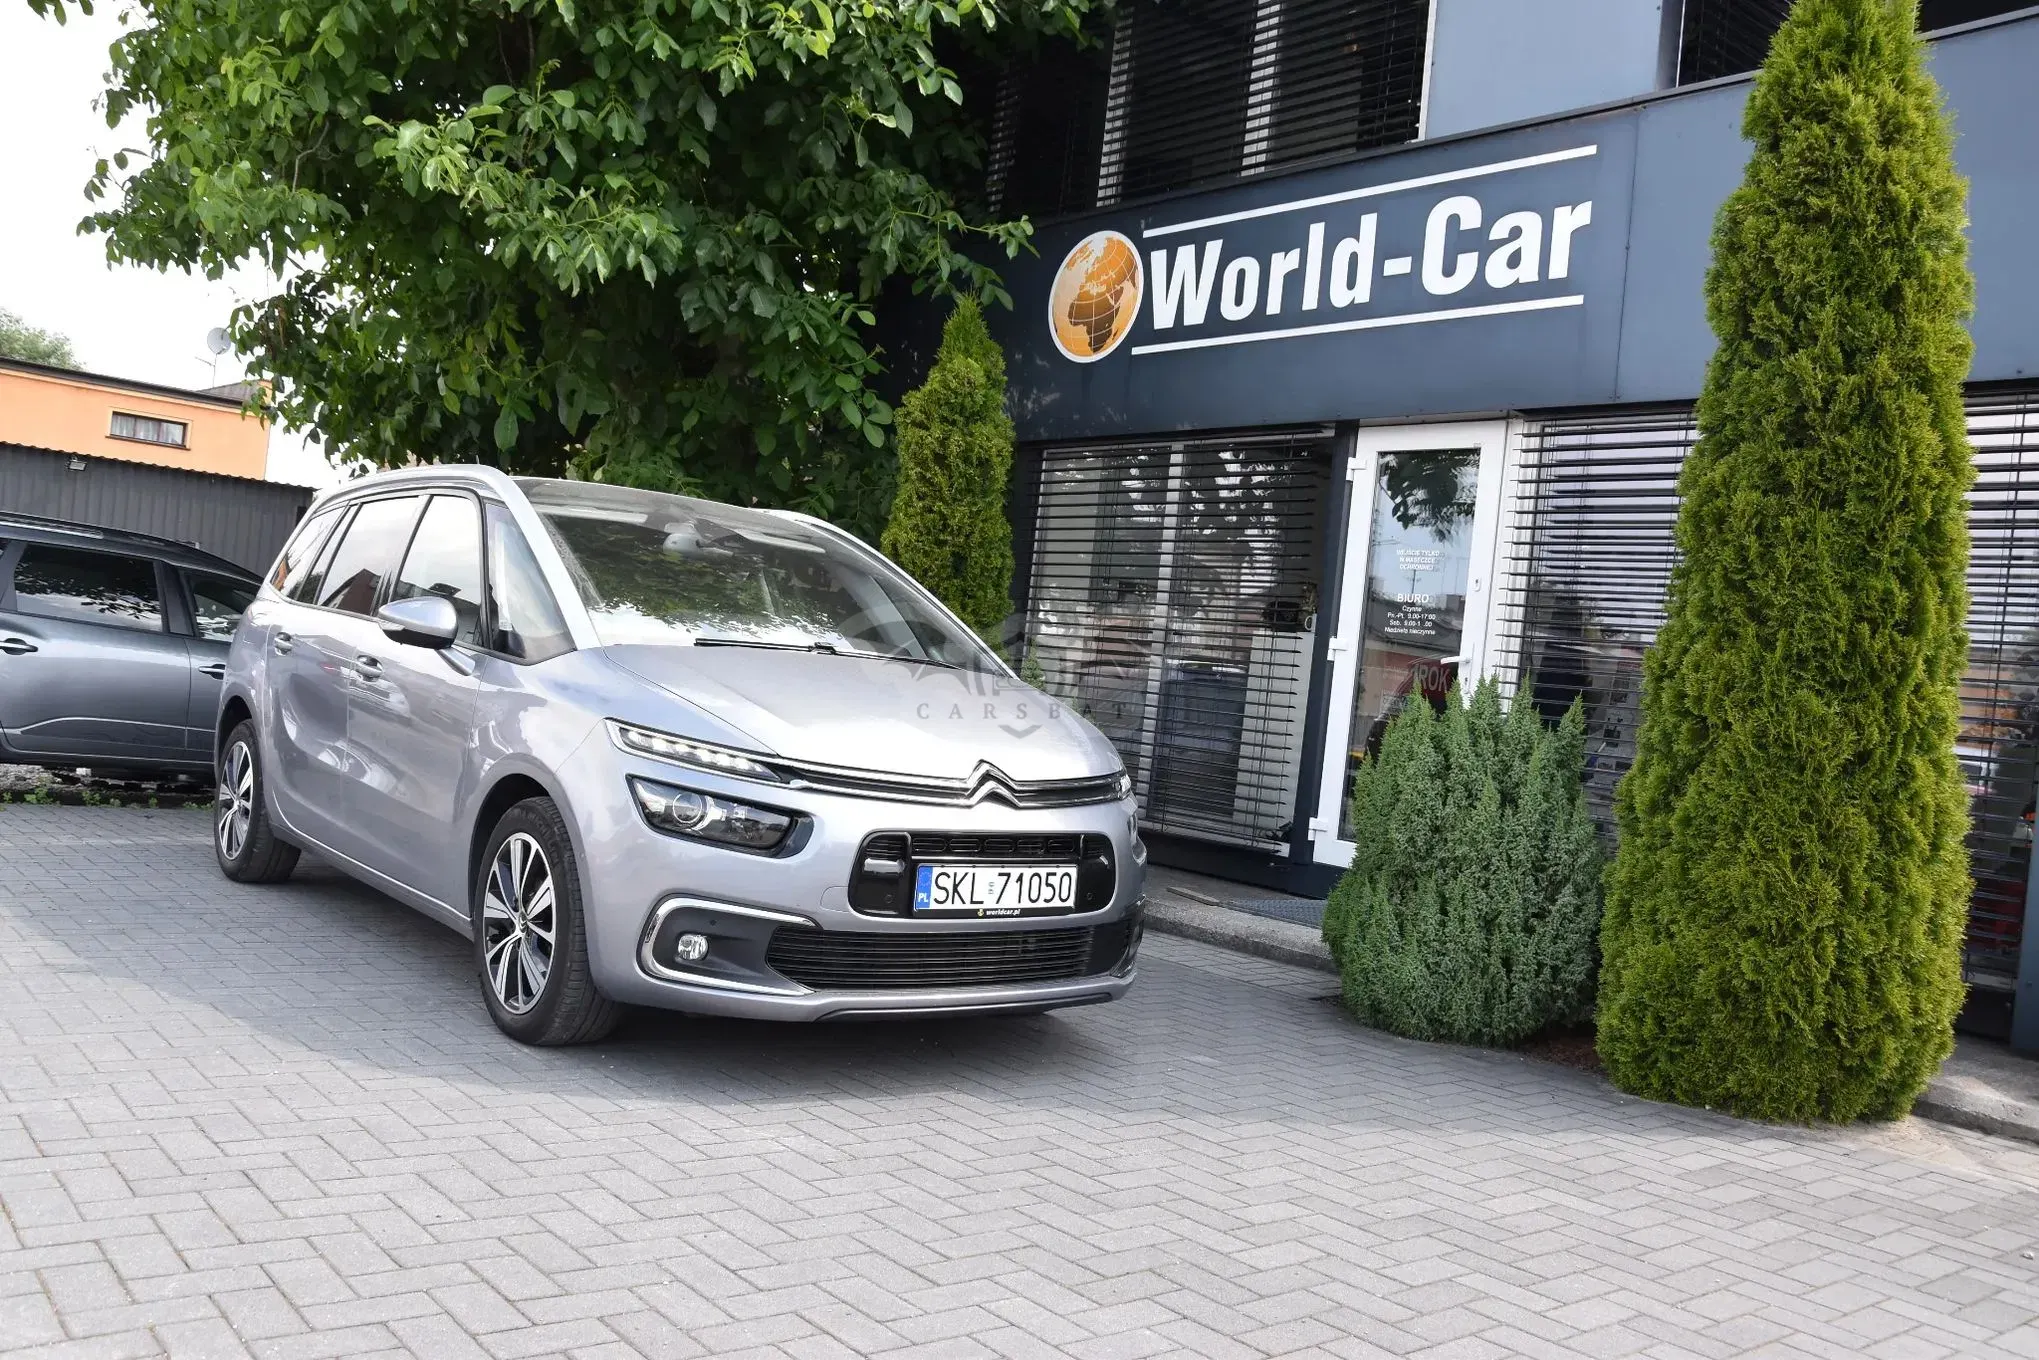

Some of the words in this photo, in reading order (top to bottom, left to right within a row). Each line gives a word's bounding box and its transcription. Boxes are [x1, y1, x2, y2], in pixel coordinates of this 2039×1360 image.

[1149, 194, 1593, 330] World-Car
[1397, 593, 1429, 603] BIURO
[1402, 604, 1422, 612] Czynne
[917, 893, 929, 903] PL
[933, 871, 985, 905] SKL
[995, 871, 1073, 905] 71050
[986, 908, 1021, 917] worldcar.pl
